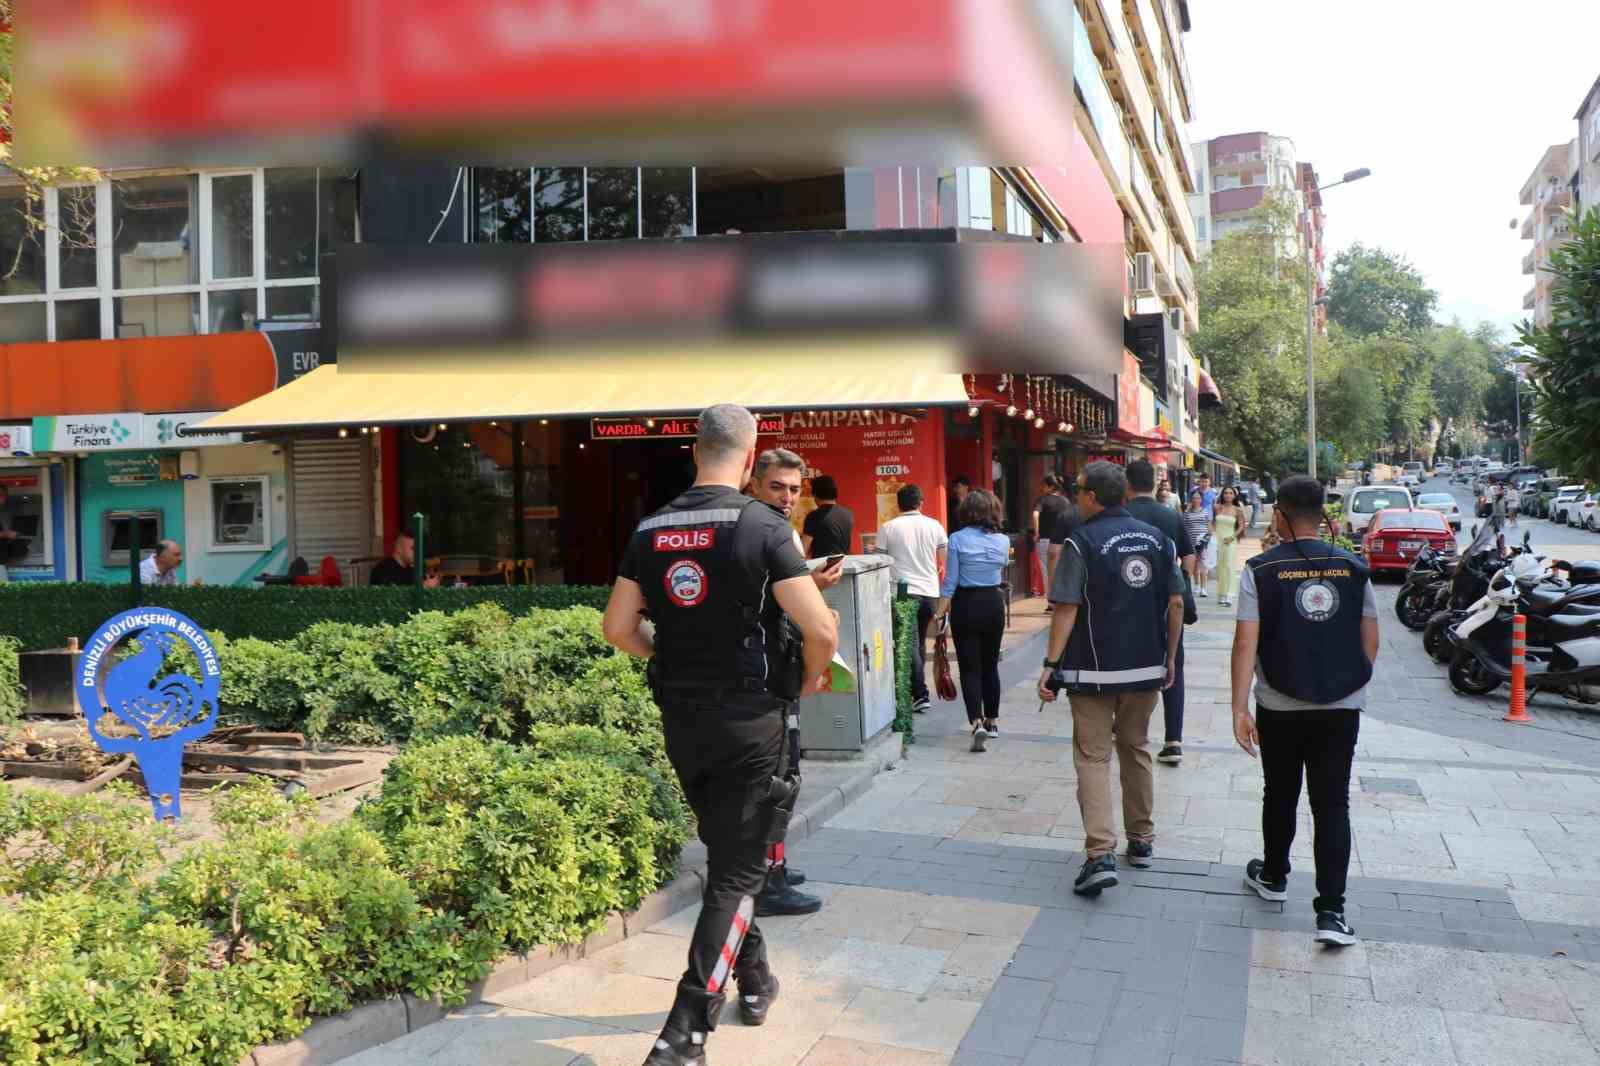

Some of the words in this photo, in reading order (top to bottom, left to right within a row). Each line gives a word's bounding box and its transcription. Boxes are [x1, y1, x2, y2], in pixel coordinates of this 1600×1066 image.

[783, 409, 918, 428] AMPANYA
[66, 424, 107, 436] Türkiye
[73, 435, 111, 447] Finans
[880, 466, 898, 474] 100
[656, 531, 710, 548] POLİS
[1278, 570, 1308, 580] GÖÇMEN
[83, 638, 107, 687] DENİZLİ
[104, 613, 177, 643] BÜYÜKŞEHİR
[178, 622, 221, 676] BELEDİYESİ
